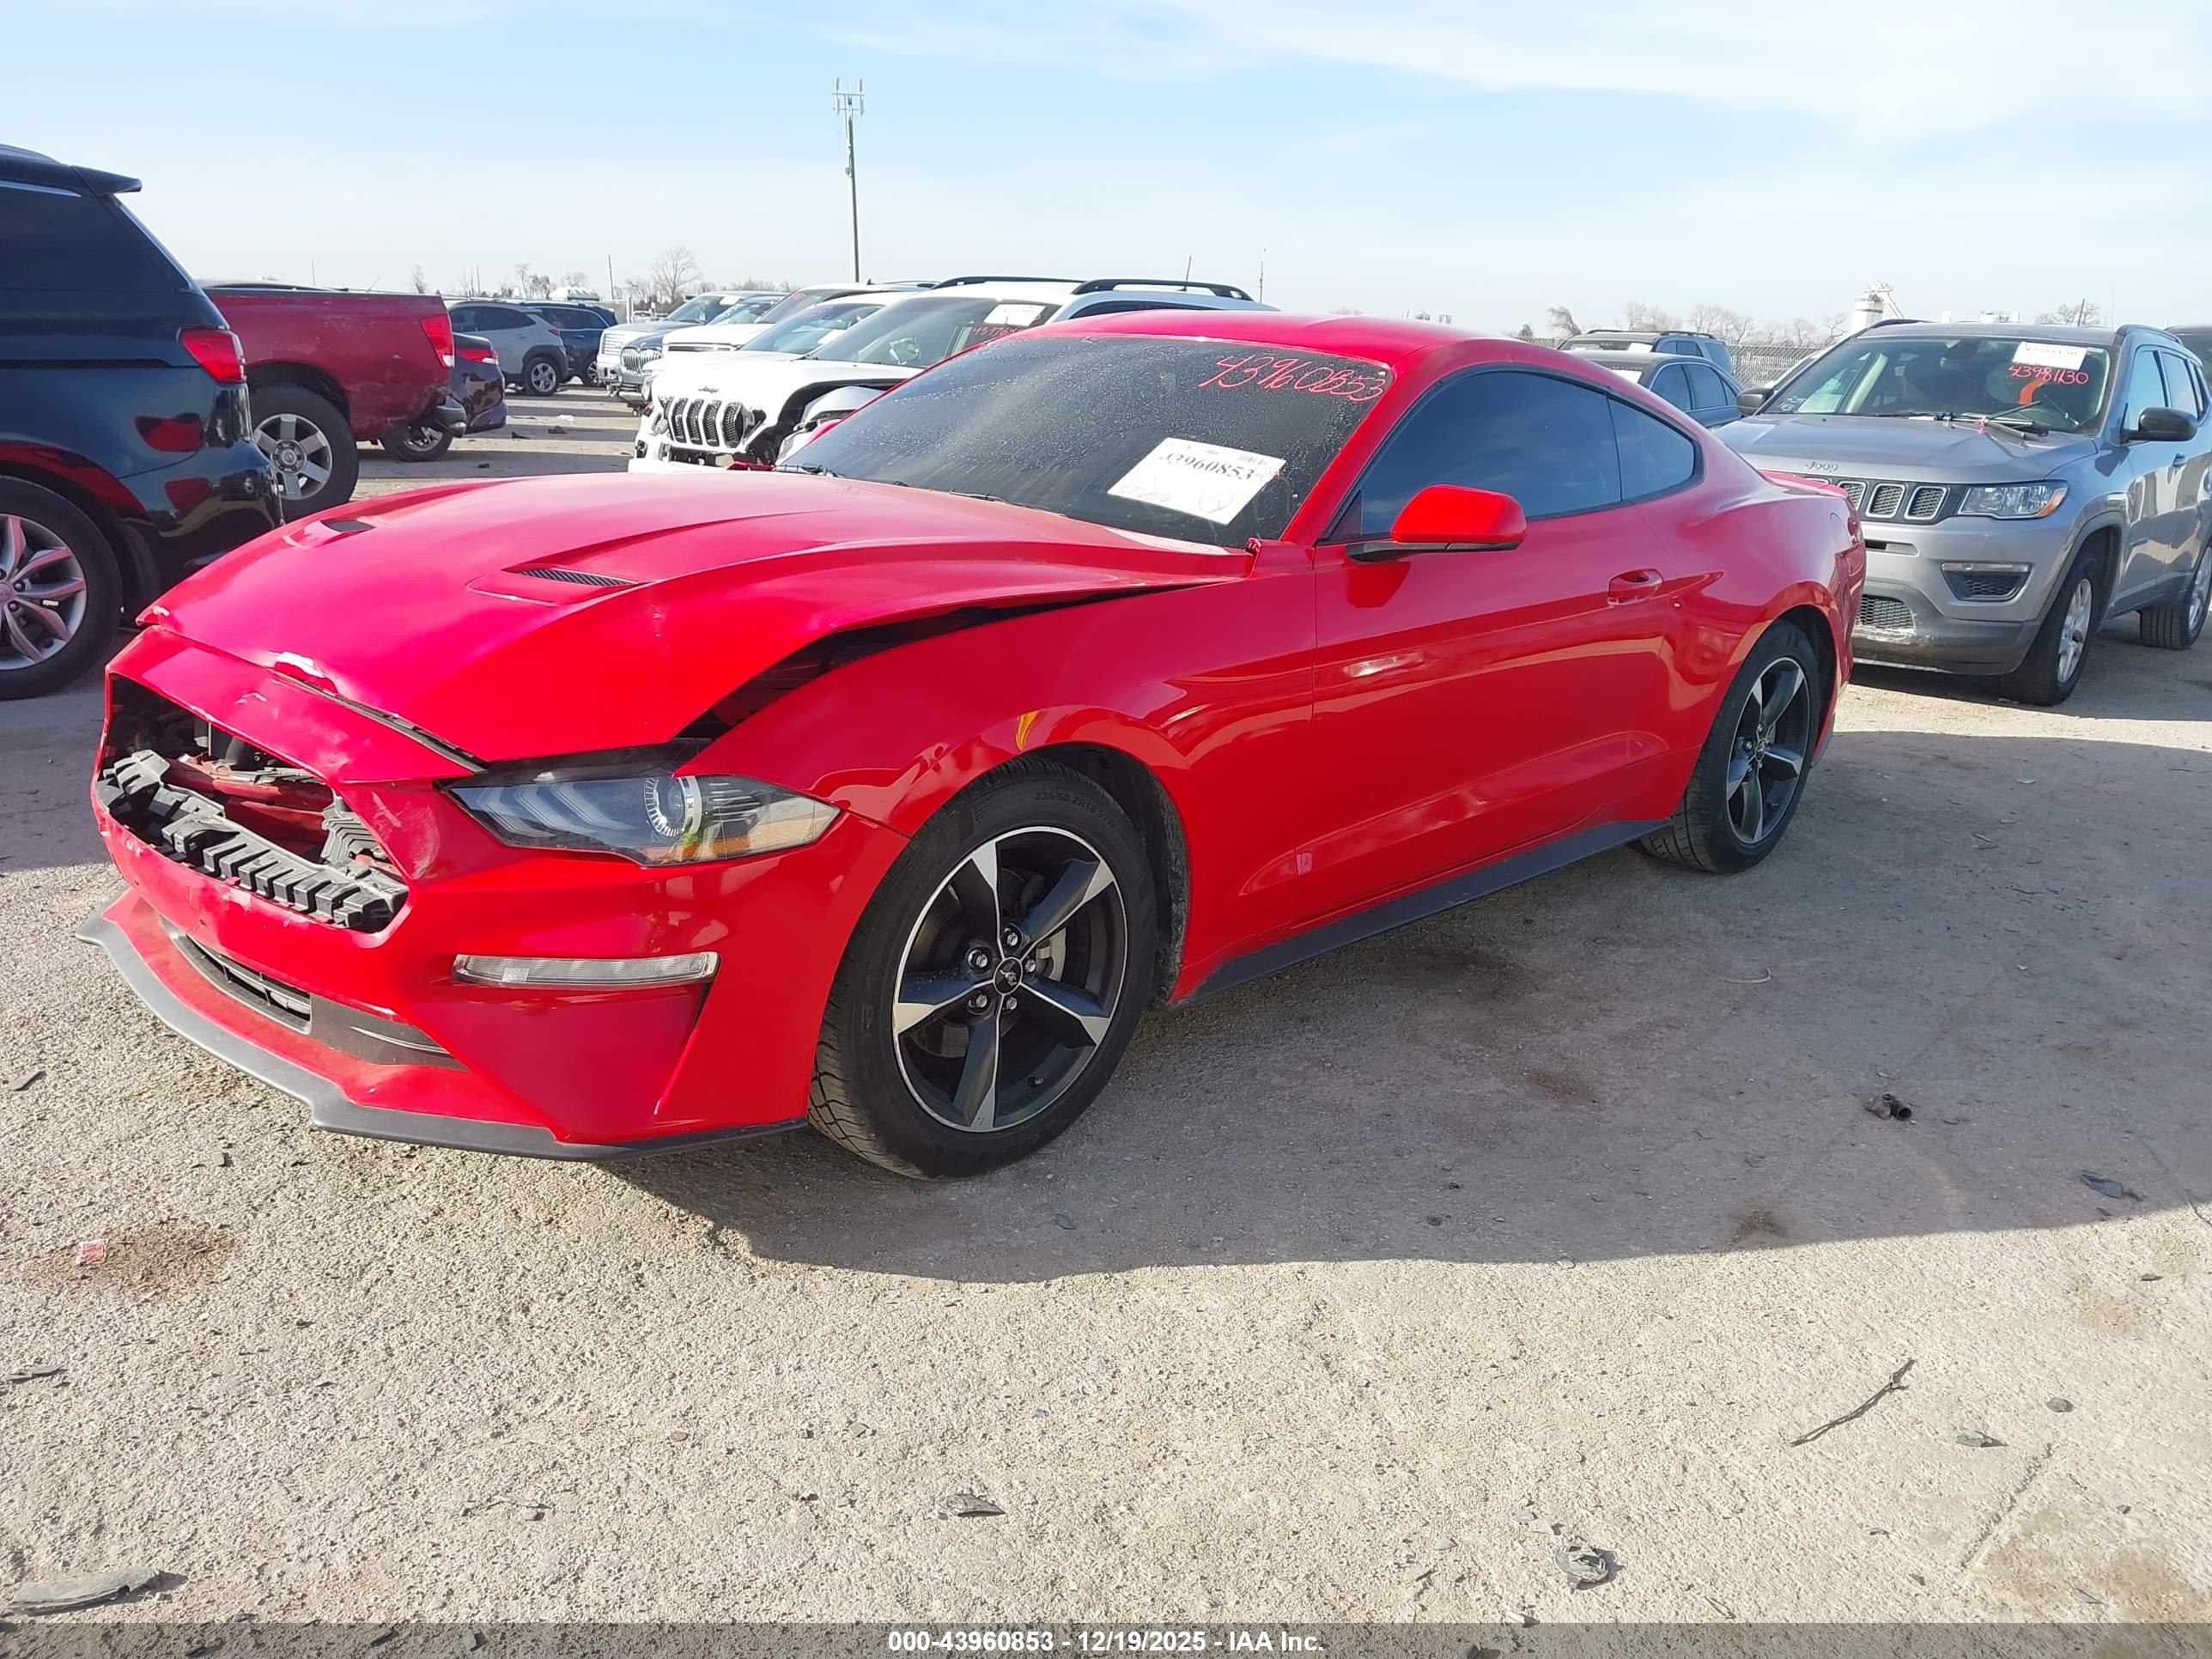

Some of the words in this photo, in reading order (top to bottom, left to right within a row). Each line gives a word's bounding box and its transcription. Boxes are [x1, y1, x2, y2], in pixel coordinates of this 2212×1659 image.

[1198, 354, 1386, 402] 43960853
[2008, 365, 2089, 385] 43981130
[1804, 459, 1839, 472] Jeep
